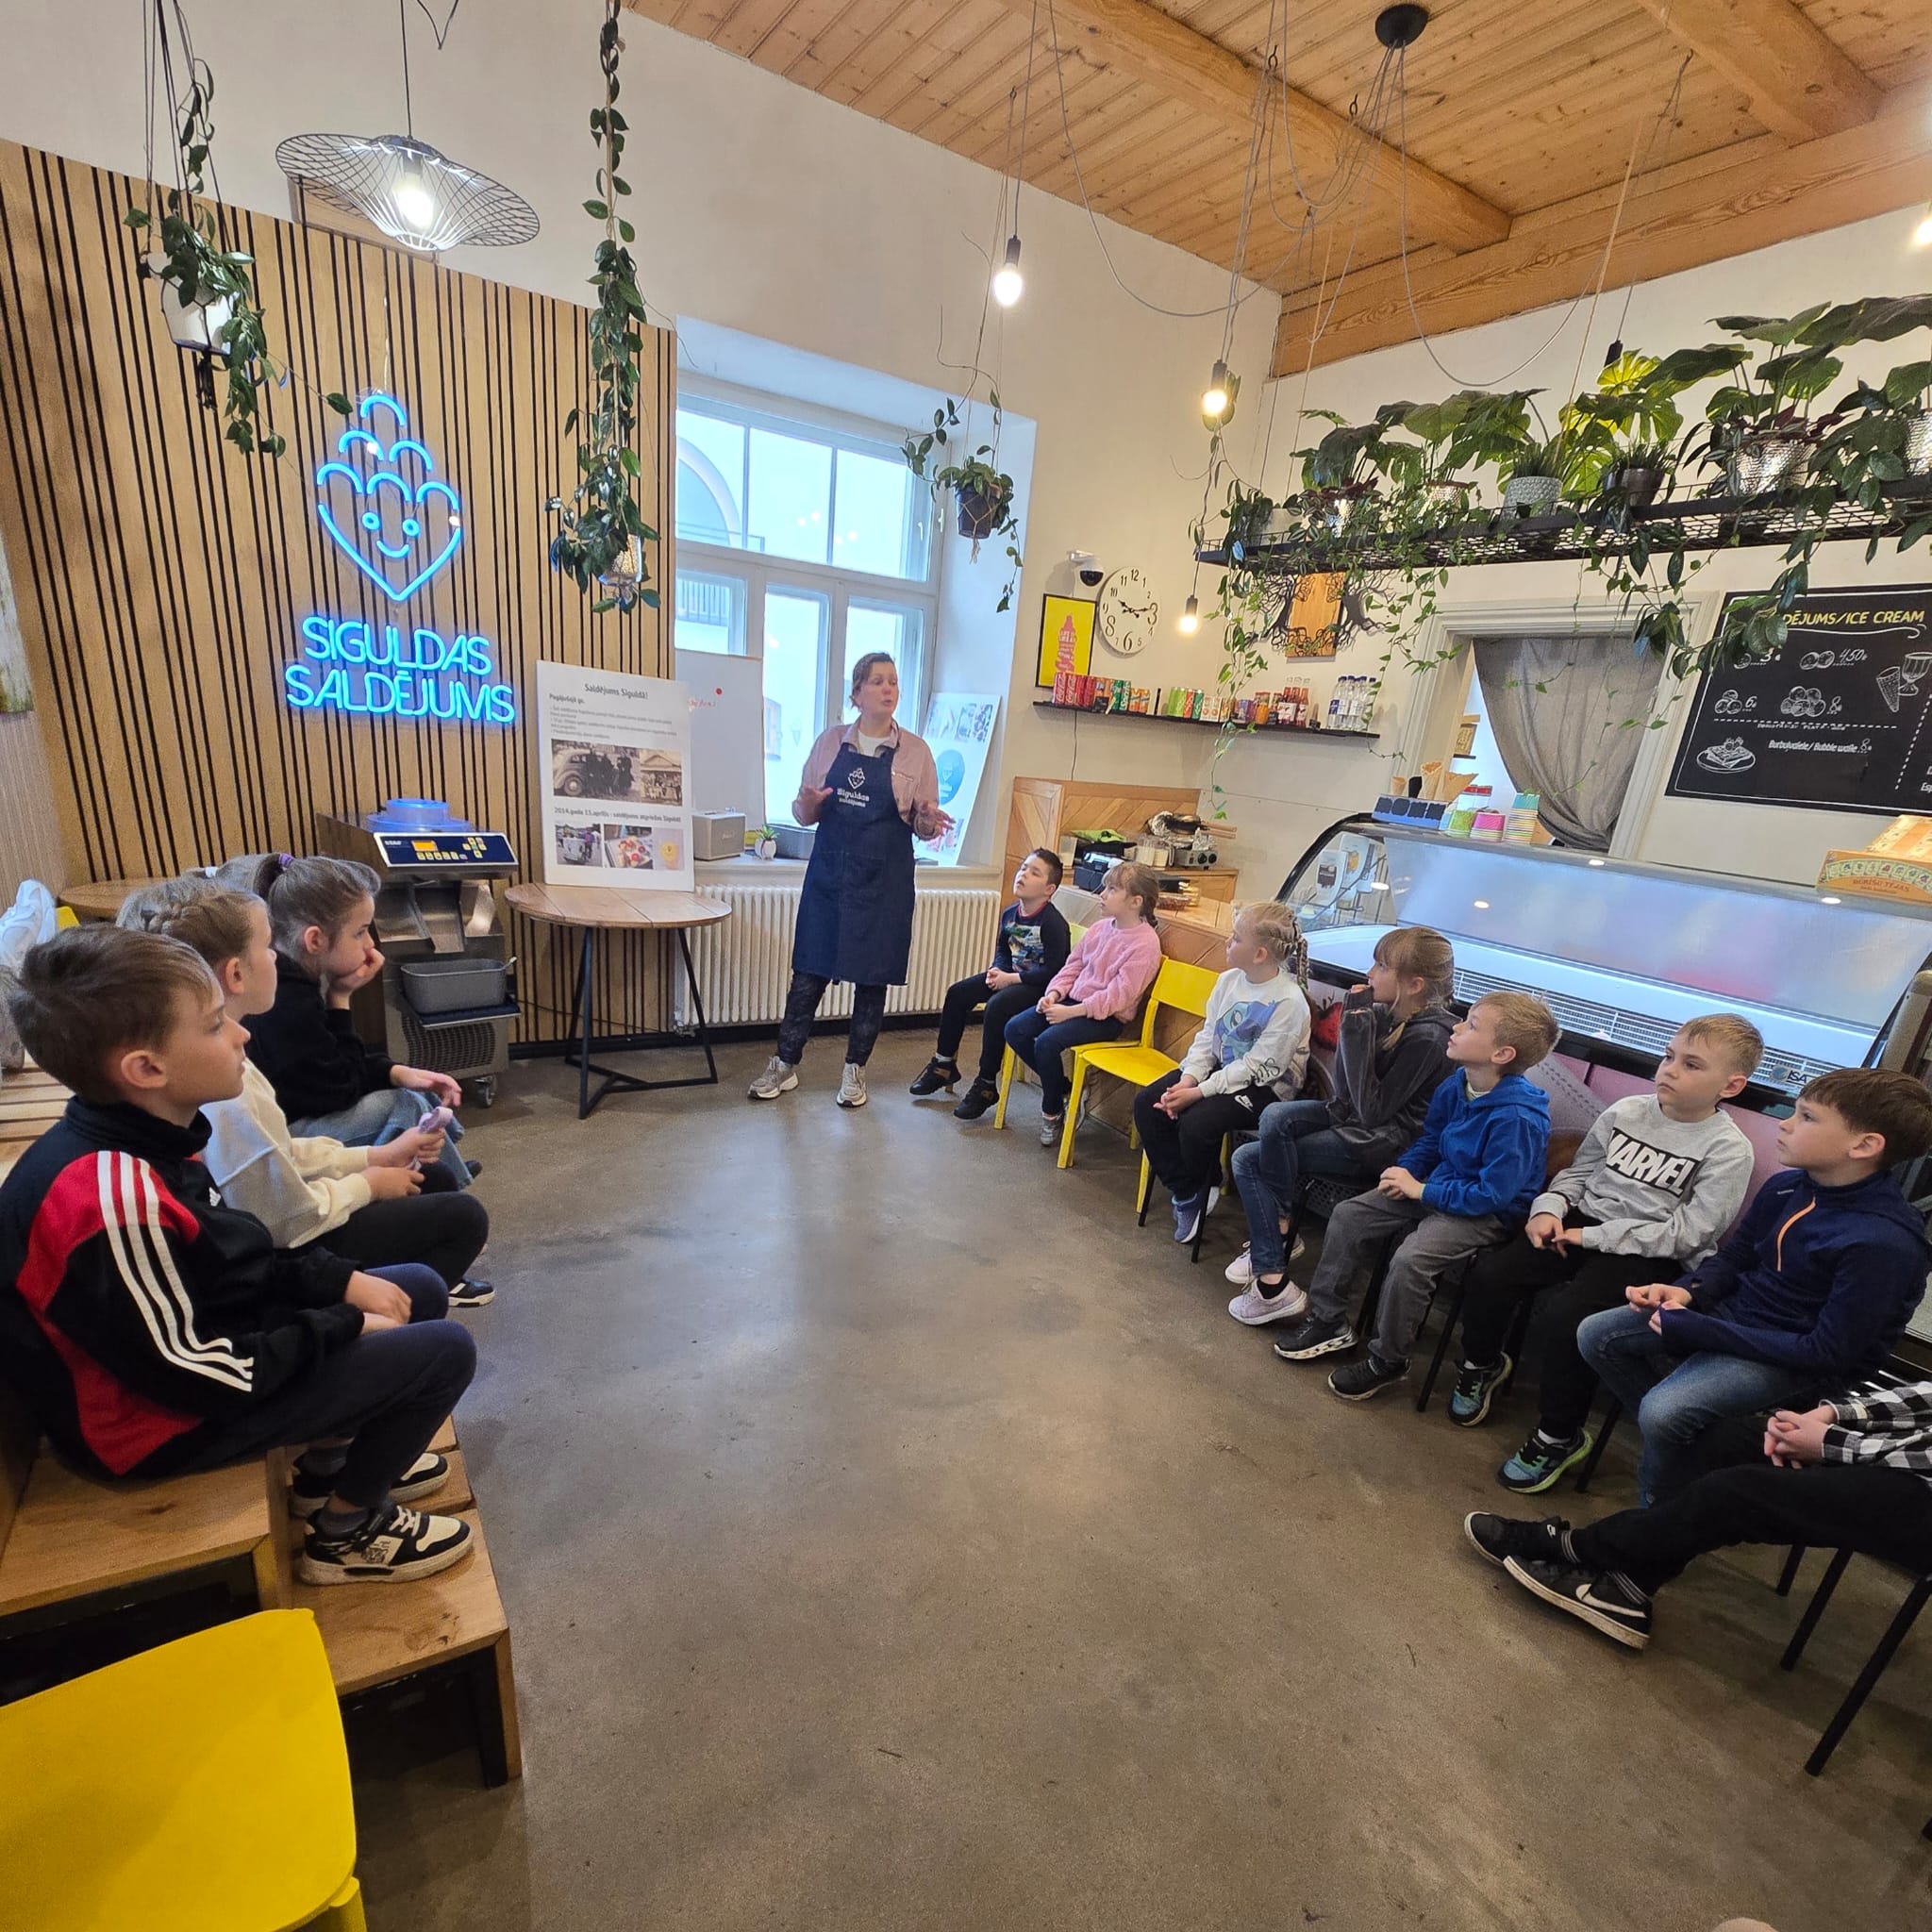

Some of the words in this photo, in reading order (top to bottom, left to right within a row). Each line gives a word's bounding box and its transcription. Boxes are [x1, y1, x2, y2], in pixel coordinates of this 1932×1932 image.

[1121, 575, 1128, 587] 11
[1131, 569, 1140, 582] 12
[1142, 577, 1146, 588] 1
[1110, 588, 1118, 597] 10
[1147, 591, 1152, 599] 2
[1103, 603, 1109, 614] 9
[1147, 602, 1158, 625] 3
[1782, 610, 1870, 625] DĒJUMS/ICE
[1873, 610, 1925, 625] CREAM
[1105, 615, 1116, 637] 8
[302, 615, 492, 676] SIGULDAS
[1123, 631, 1133, 651] 6
[1137, 638, 1142, 646] 5
[285, 663, 515, 724] SALDĒJUMS
[1787, 1070, 1808, 1083] ISA
